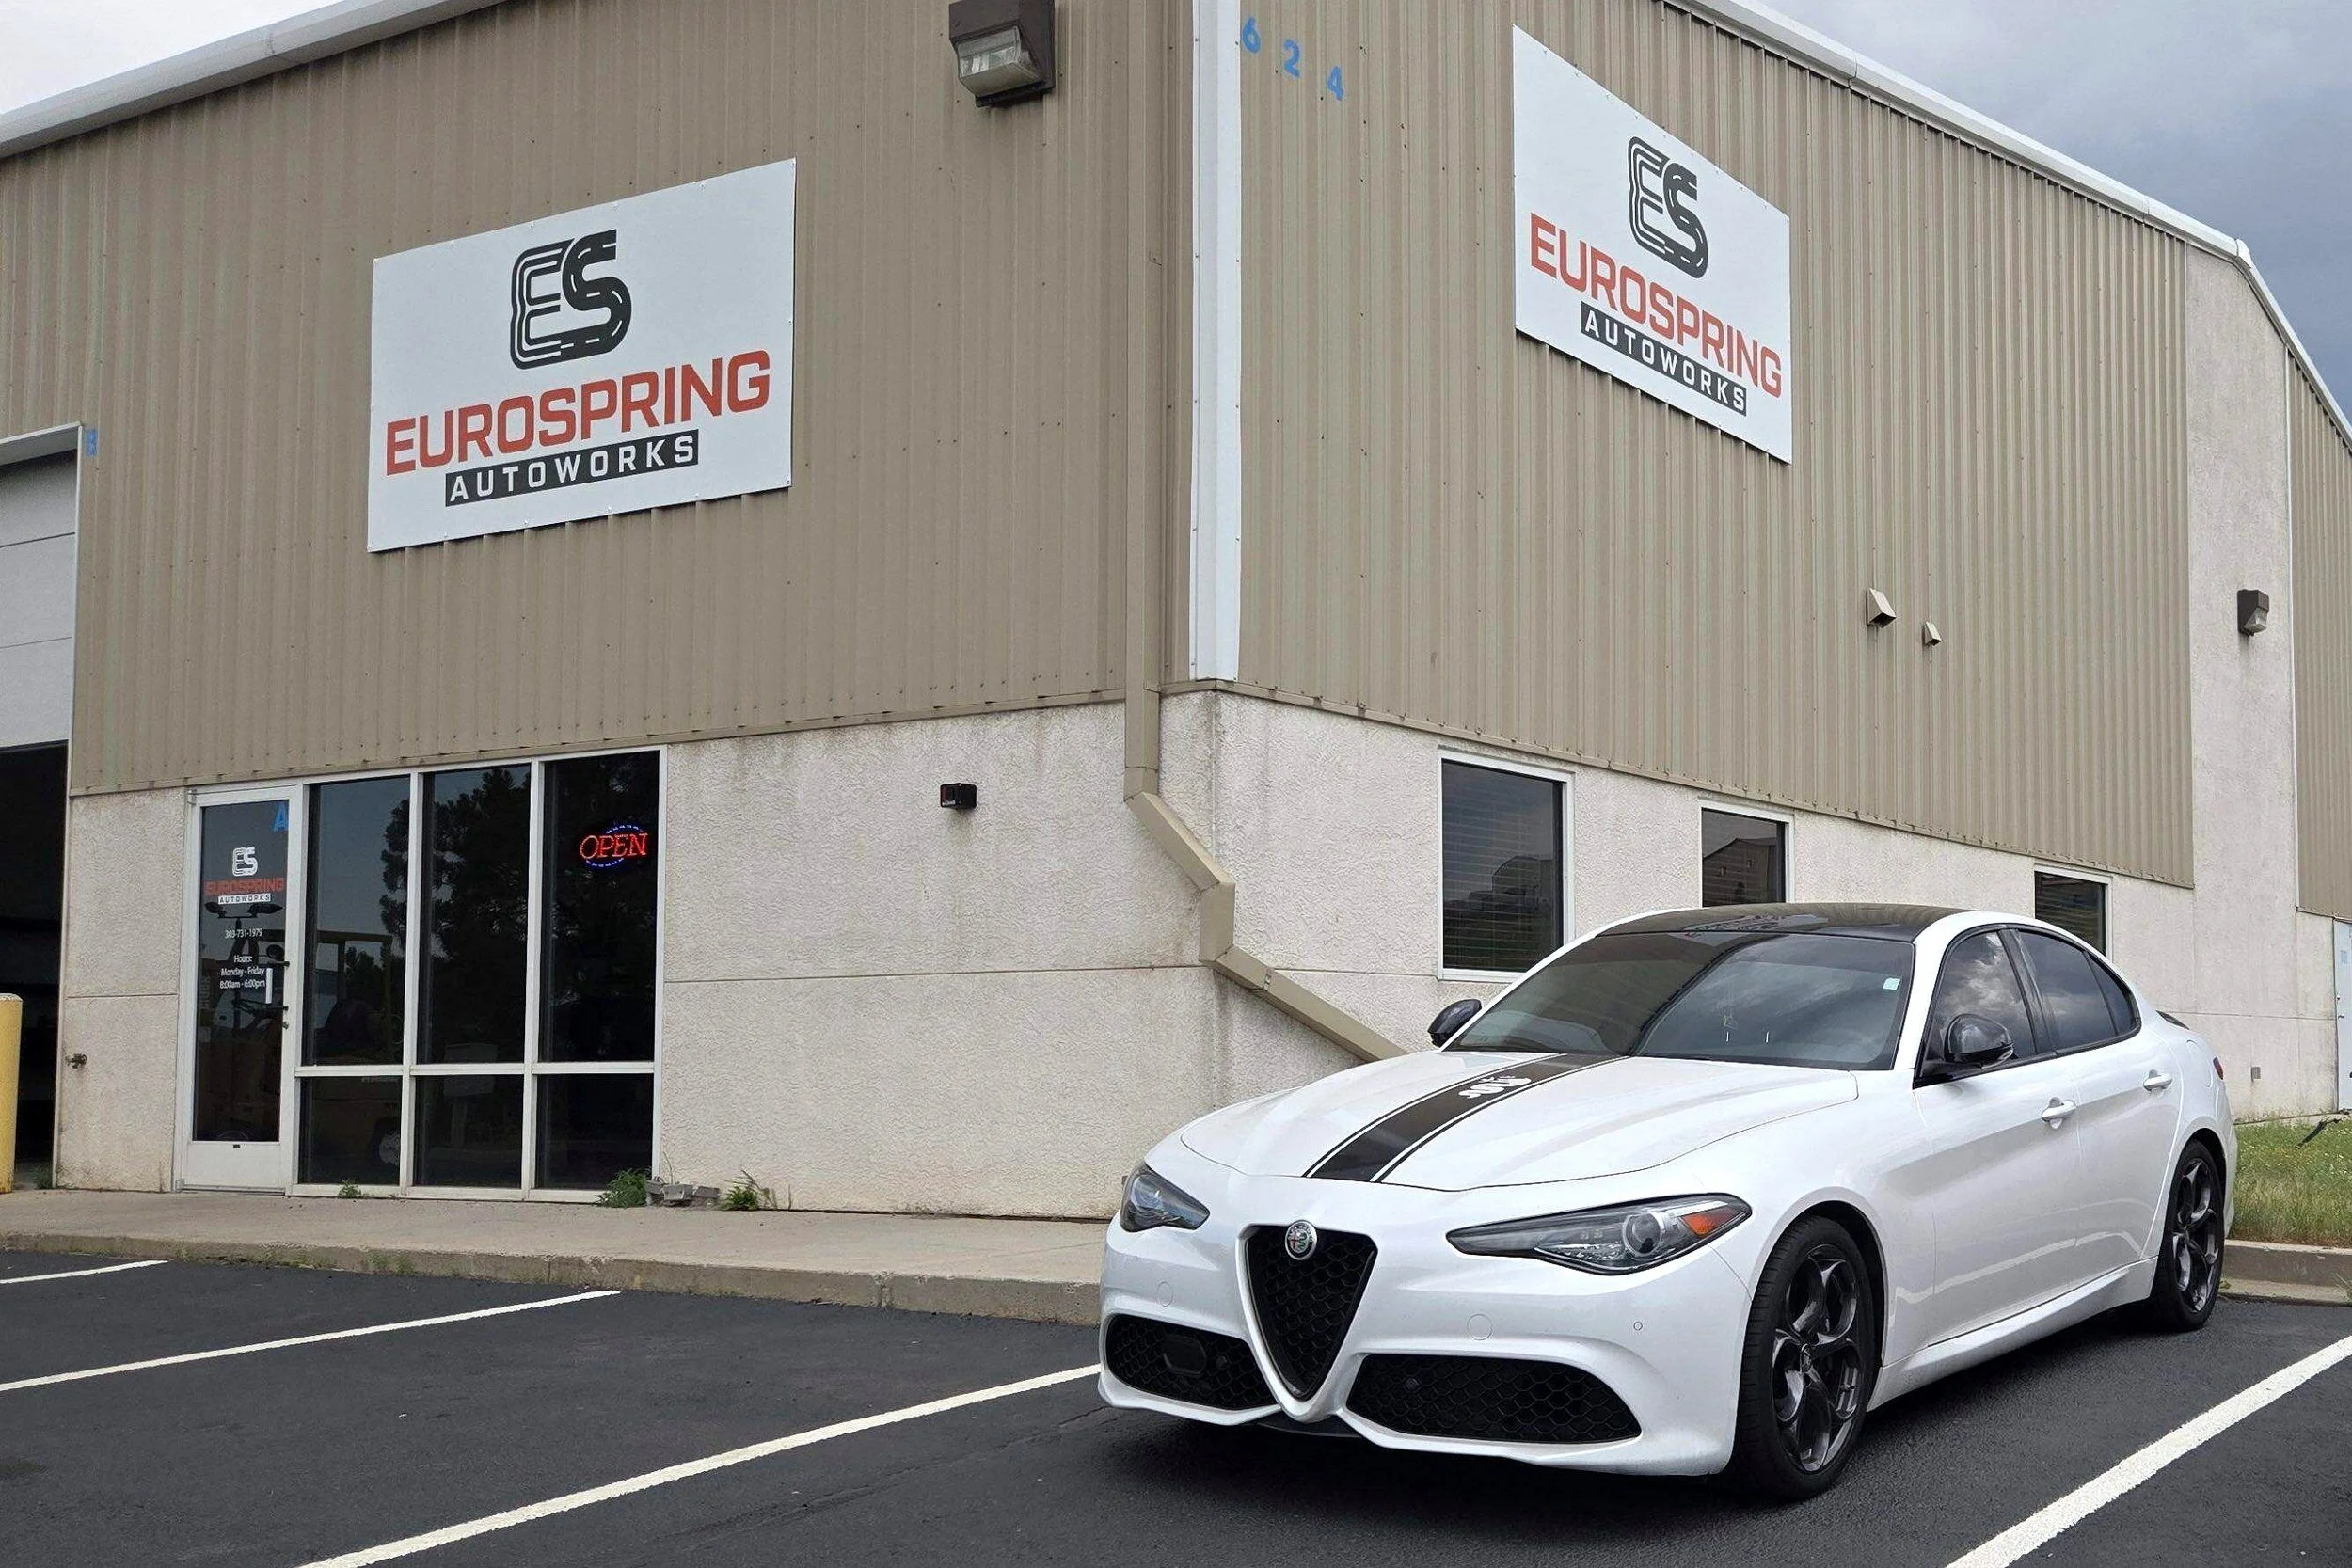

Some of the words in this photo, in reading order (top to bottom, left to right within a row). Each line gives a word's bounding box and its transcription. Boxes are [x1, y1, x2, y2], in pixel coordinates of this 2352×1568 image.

[1628, 136, 1708, 278] ES
[510, 229, 632, 370] ES
[1530, 212, 1782, 399] EUROSPRING
[1584, 309, 1744, 412] AUTOWORKS
[387, 350, 771, 476] EUROSPRING
[449, 434, 695, 503] AUTOWORKS
[272, 801, 288, 832] A
[580, 833, 648, 859] OPEN
[232, 847, 258, 877] ES
[219, 894, 270, 904] AUTOWORKS
[220, 968, 244, 977] Monday
[247, 966, 265, 976] Friday
